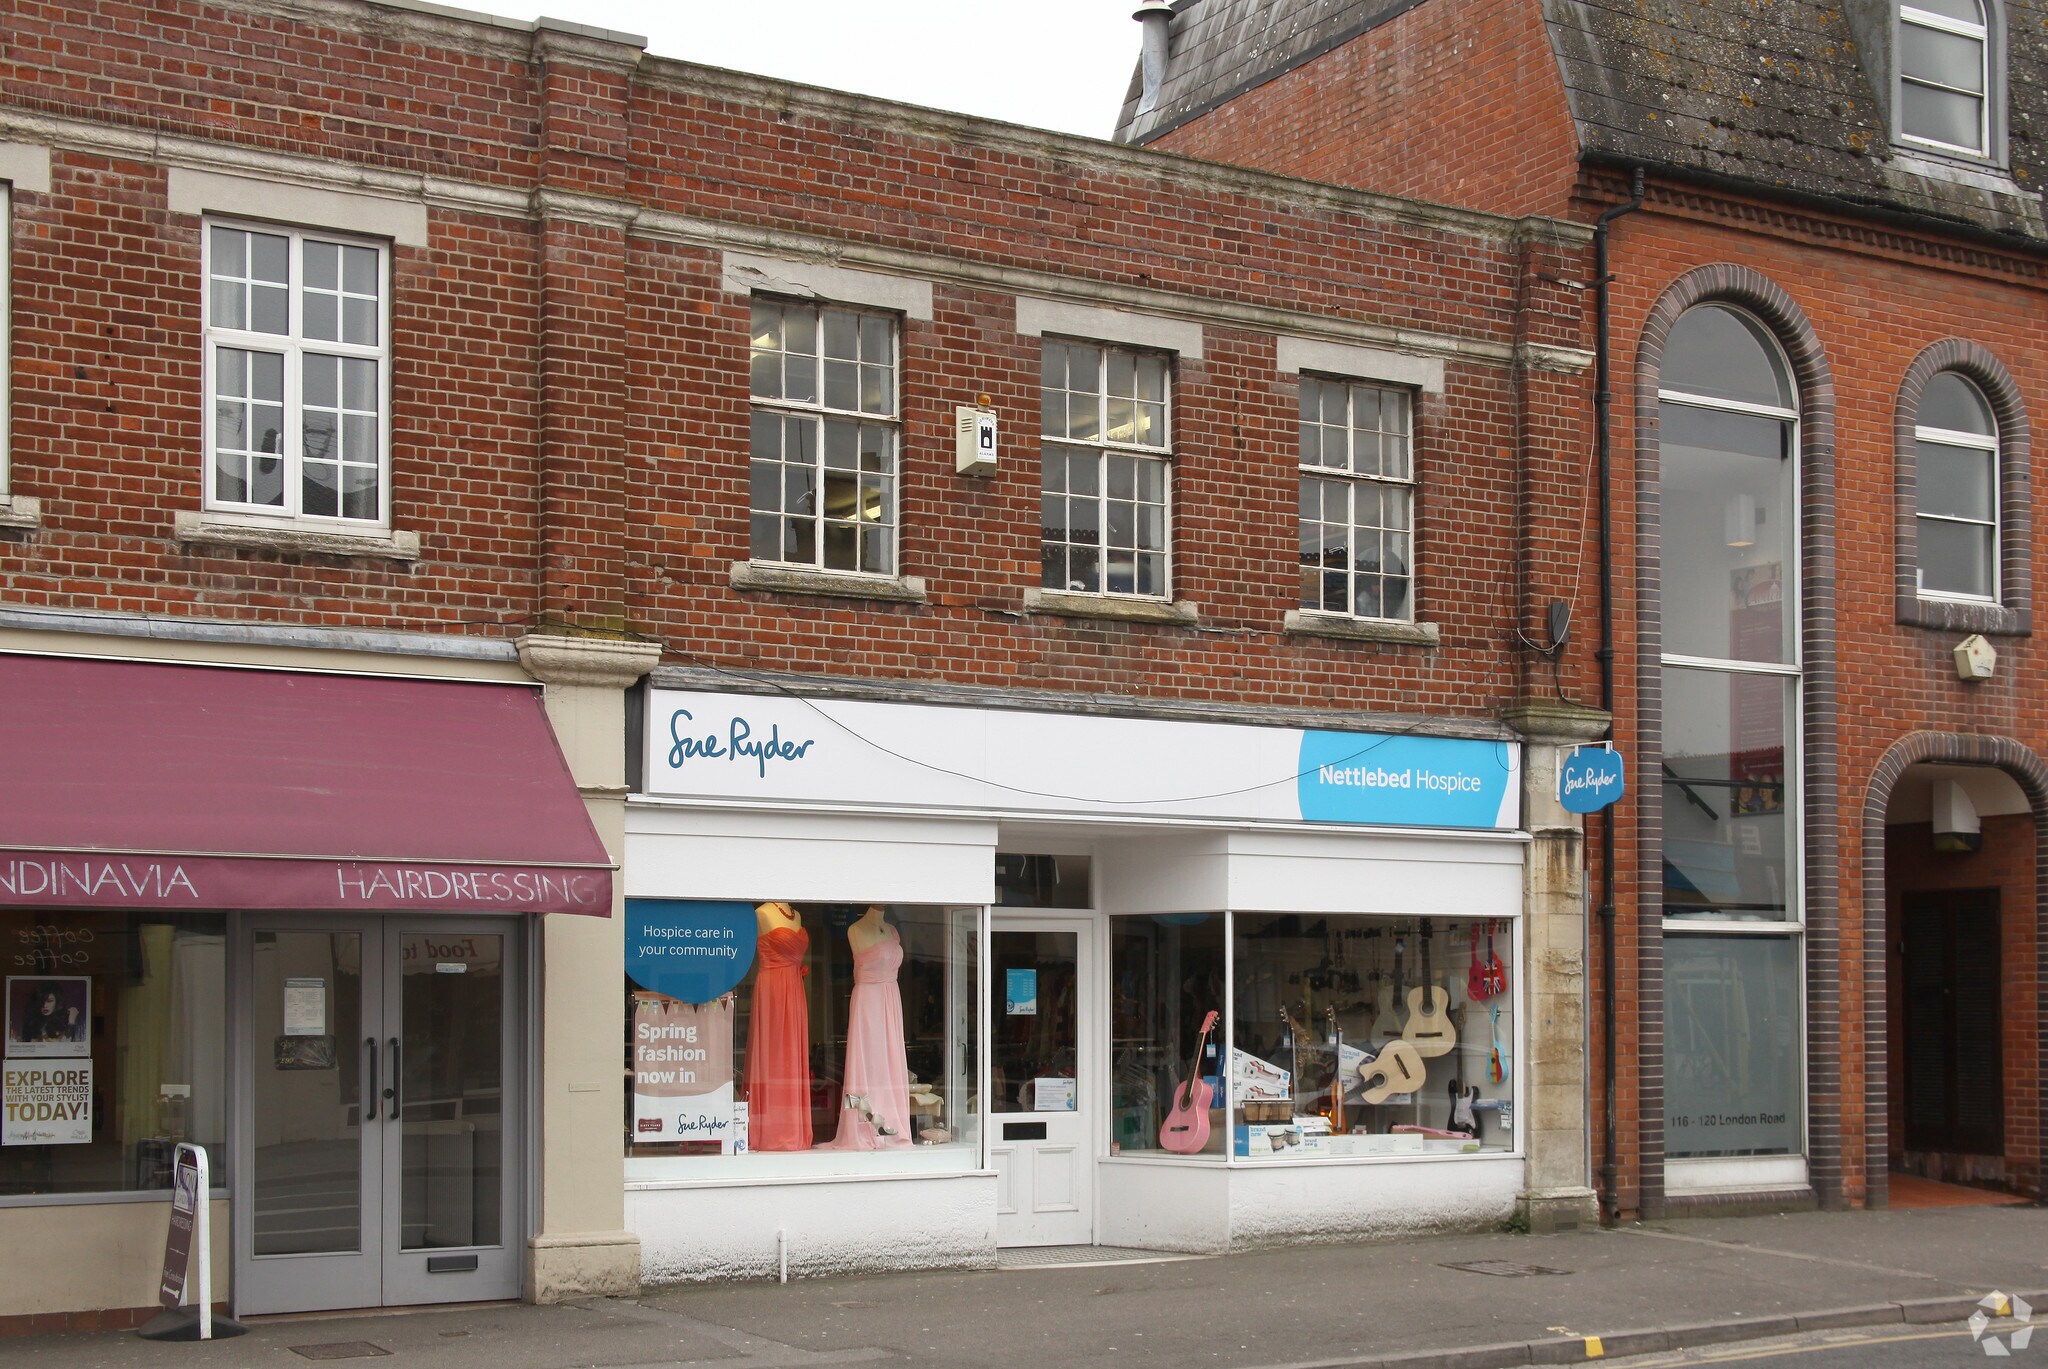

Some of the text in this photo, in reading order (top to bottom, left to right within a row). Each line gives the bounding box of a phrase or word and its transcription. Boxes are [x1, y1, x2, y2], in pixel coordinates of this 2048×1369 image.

[669, 709, 814, 778] Sue Ryder
[1319, 764, 1481, 795] Nettlebed Hospice
[1565, 767, 1617, 795] Sue Ryder
[337, 868, 597, 905] HAIRDRESSING
[643, 925, 734, 940] Hospice care in
[639, 945, 738, 959] your community
[638, 1023, 698, 1043] Spring
[637, 1045, 706, 1061] fashion
[5, 1070, 89, 1087] EXPLORE
[637, 1067, 696, 1084] now in
[6, 1086, 22, 1094] THE
[24, 1086, 55, 1094] LATEST
[5, 1102, 89, 1121] TODAY!
[1672, 1116, 1689, 1127] 116
[1700, 1114, 1717, 1126] 120
[1719, 1113, 1757, 1126] London
[1760, 1112, 1786, 1124] Road
[677, 1113, 729, 1135] Sue Ryder
